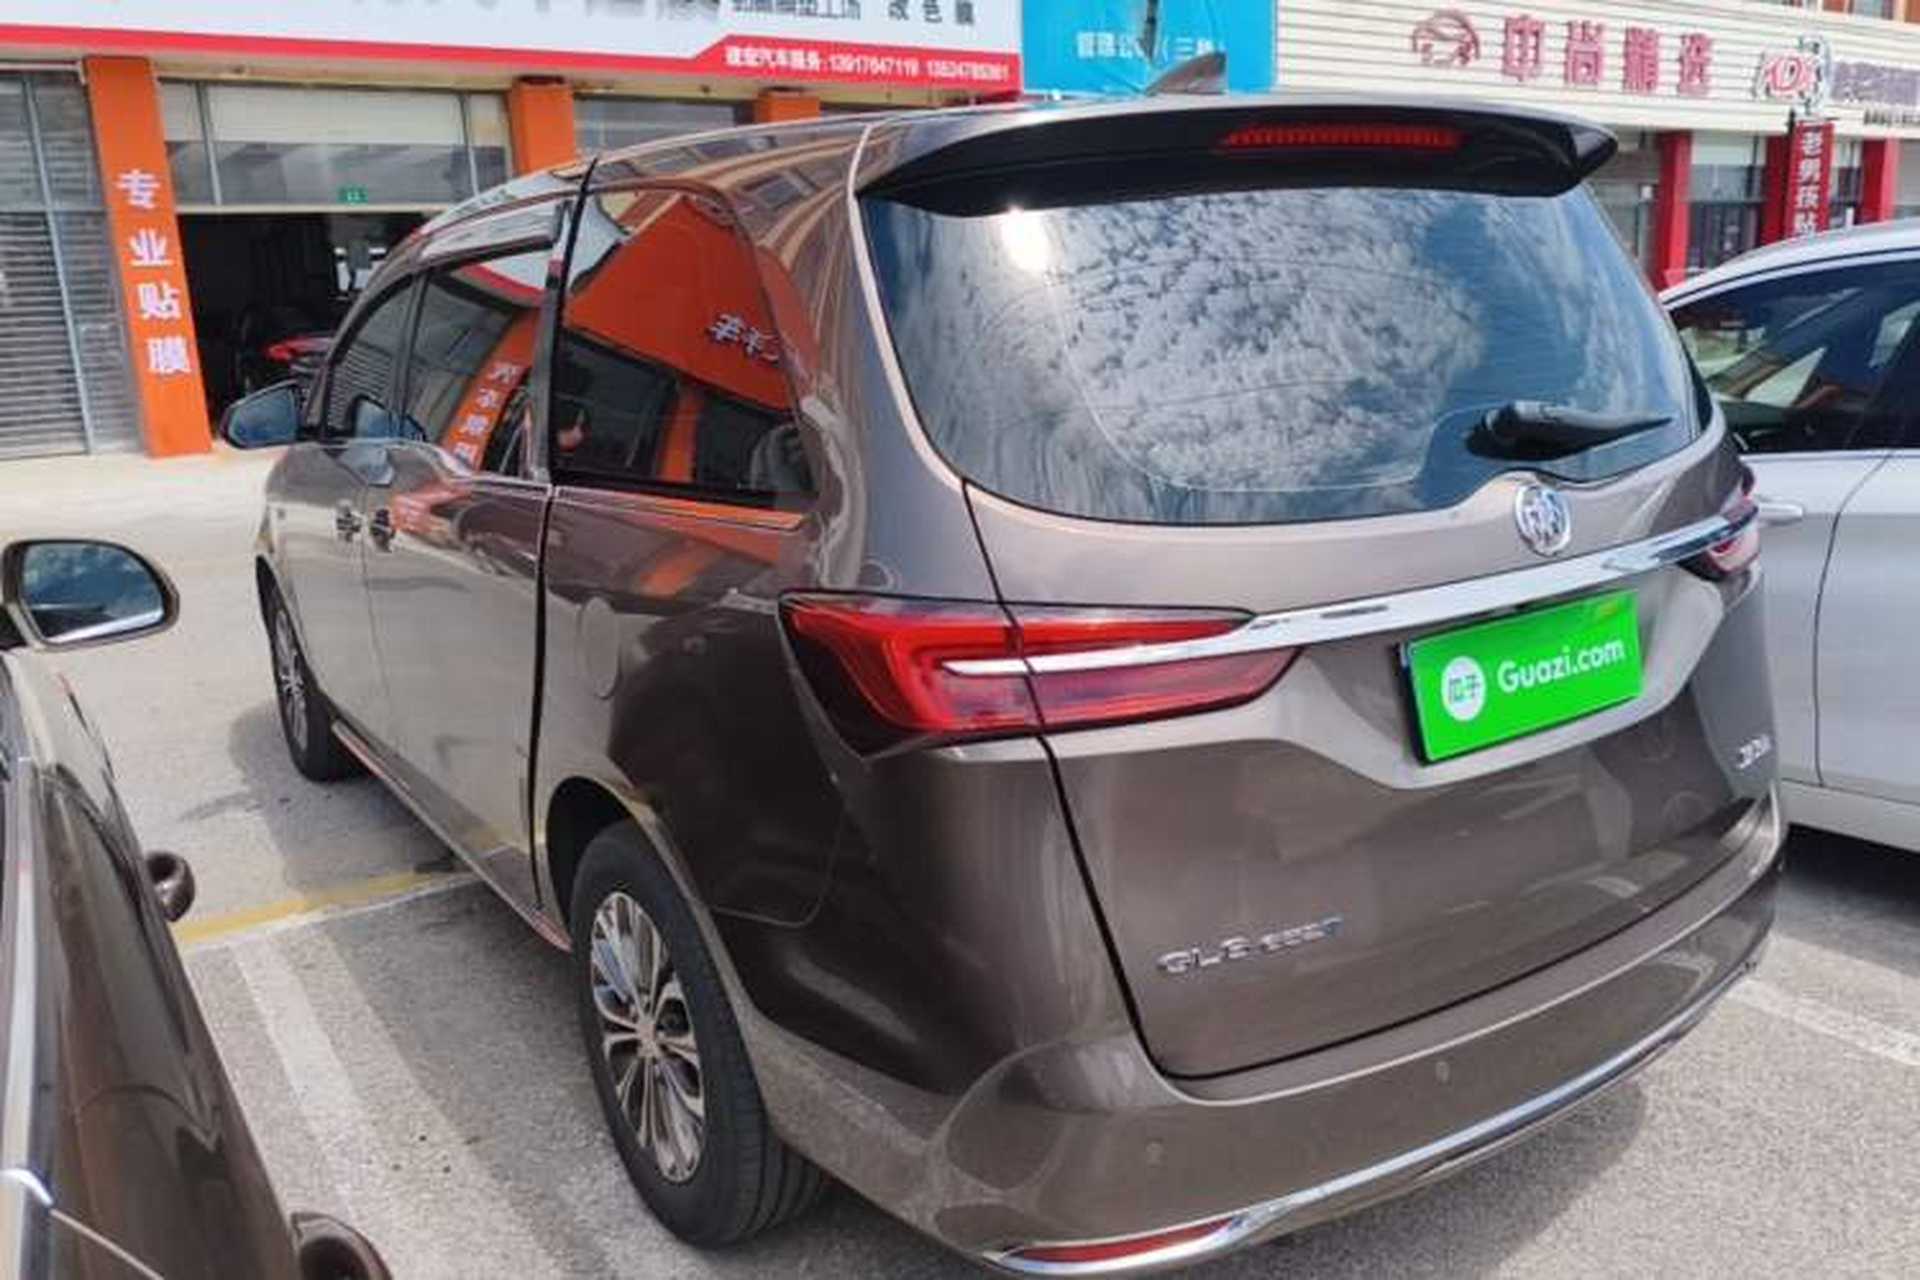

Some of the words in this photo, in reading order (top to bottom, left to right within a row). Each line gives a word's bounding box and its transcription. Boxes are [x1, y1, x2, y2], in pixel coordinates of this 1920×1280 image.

[117, 169, 191, 375] 专业贴膜
[1497, 640, 1626, 694] Guazi.com
